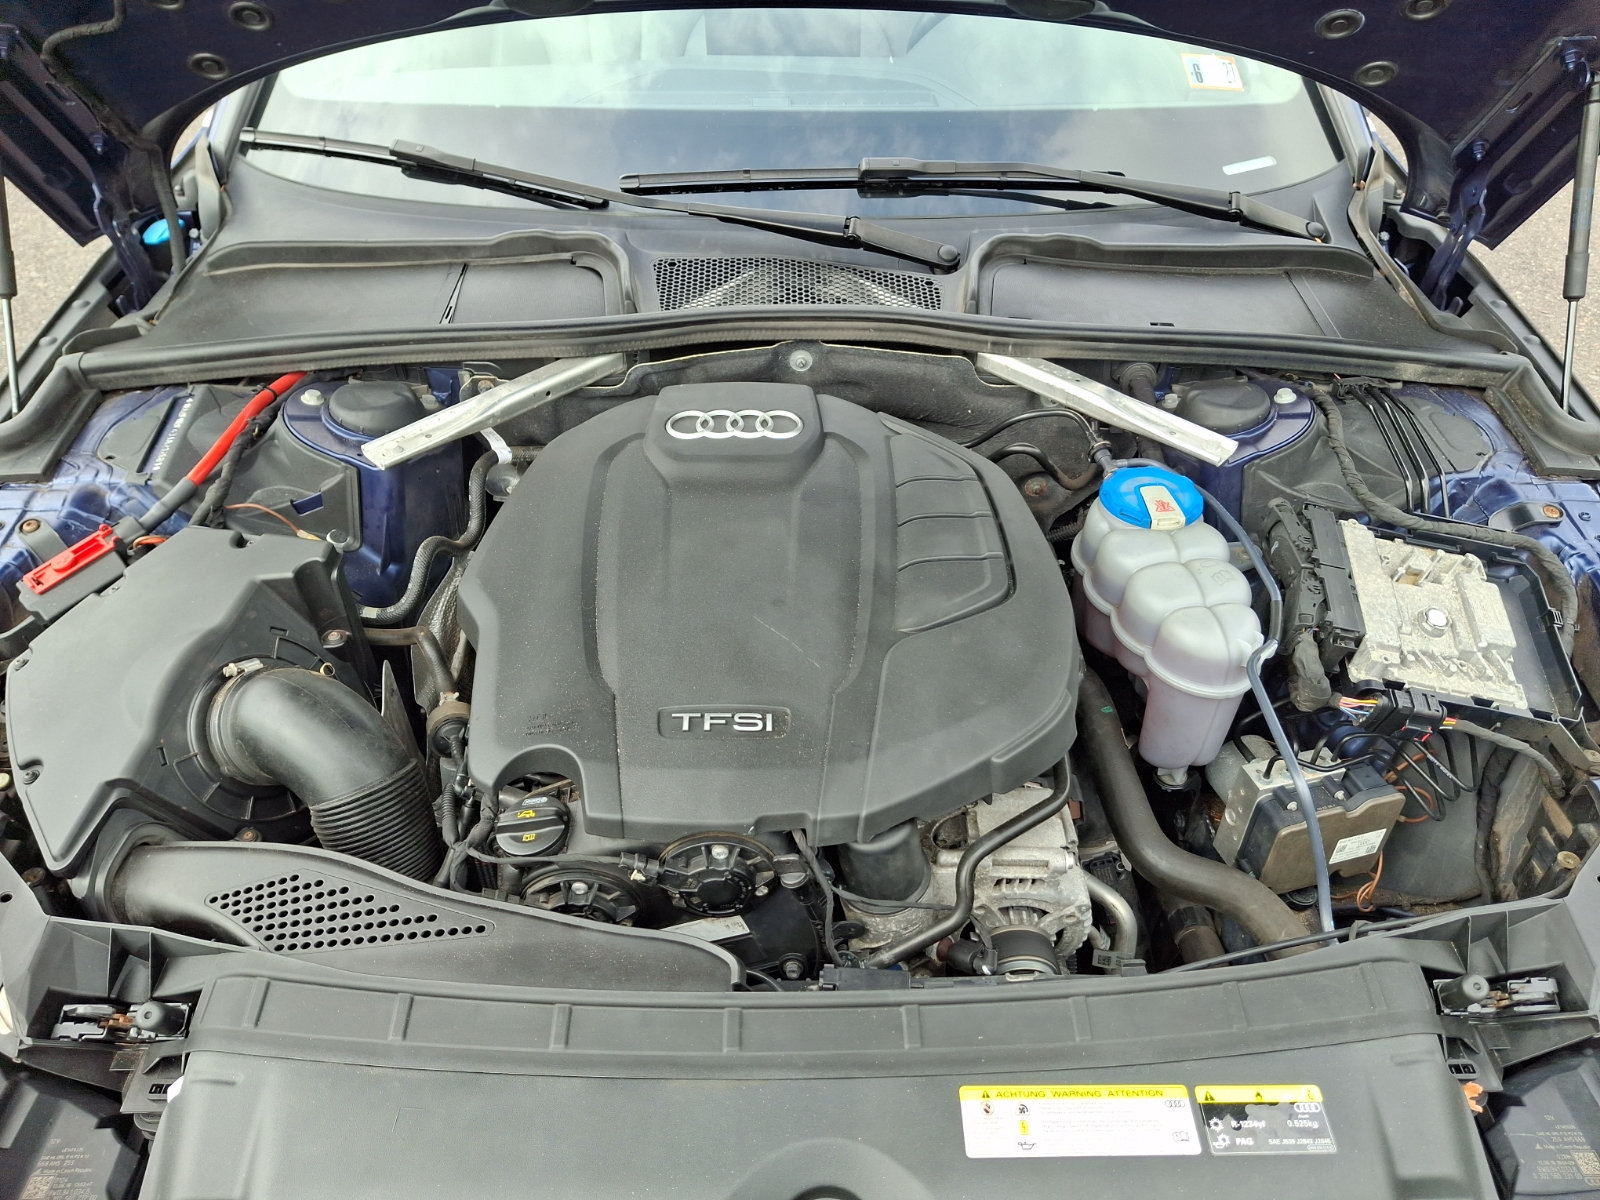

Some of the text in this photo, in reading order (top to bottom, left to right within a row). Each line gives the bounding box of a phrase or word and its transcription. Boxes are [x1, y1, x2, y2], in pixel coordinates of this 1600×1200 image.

[1192, 63, 1204, 84] 6
[671, 712, 774, 732] TFSI
[995, 1089, 1164, 1099] ACHTUNG WARNING ATTENTION
[1286, 1119, 1319, 1129] 0.525kg
[1235, 1137, 1254, 1146] PAG
